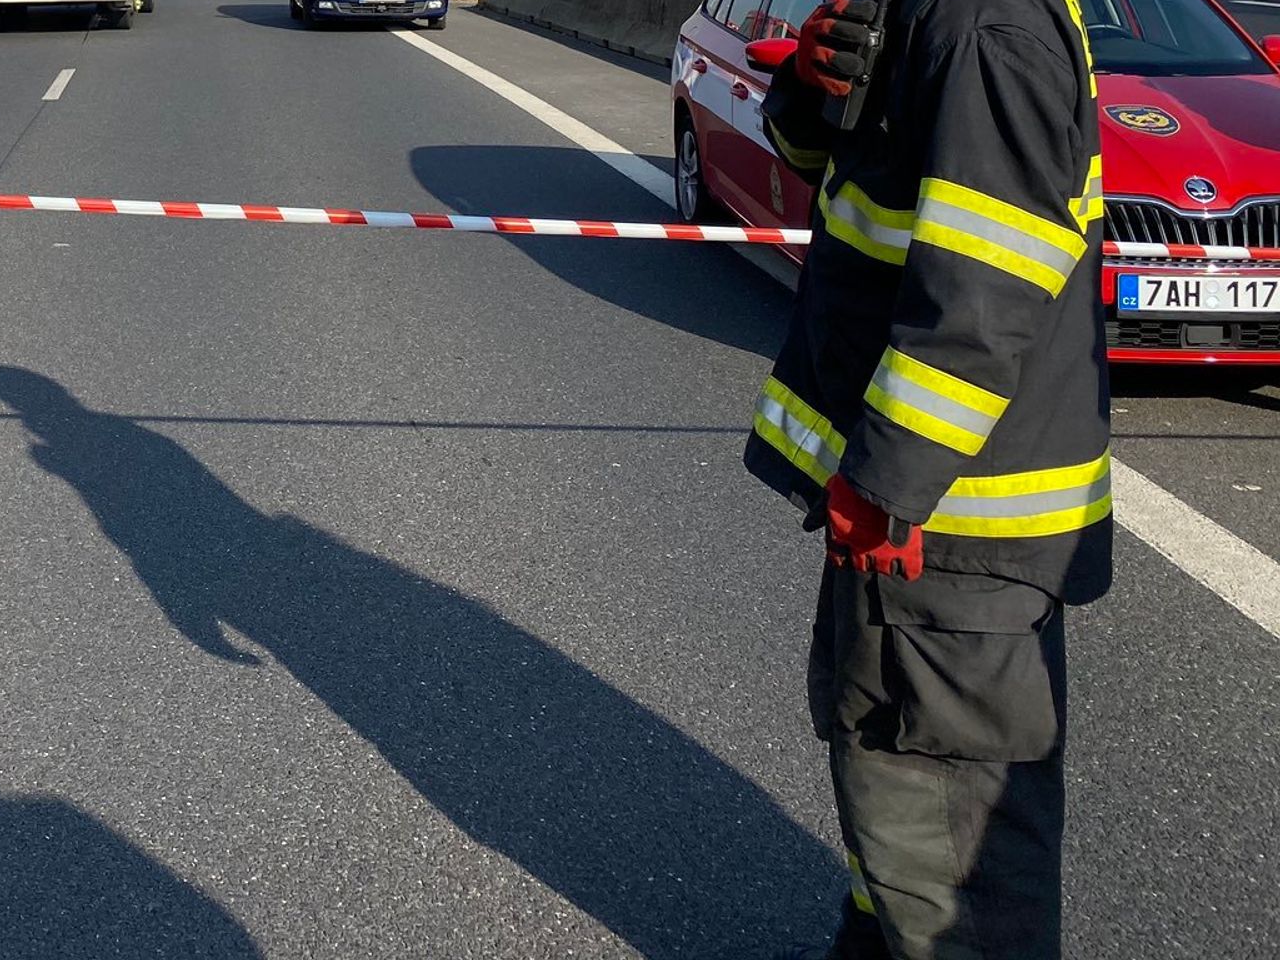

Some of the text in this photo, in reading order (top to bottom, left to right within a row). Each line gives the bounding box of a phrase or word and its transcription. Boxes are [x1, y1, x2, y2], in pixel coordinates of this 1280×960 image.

[1122, 297, 1137, 305] CZ
[1146, 279, 1278, 308] 7AH 117
